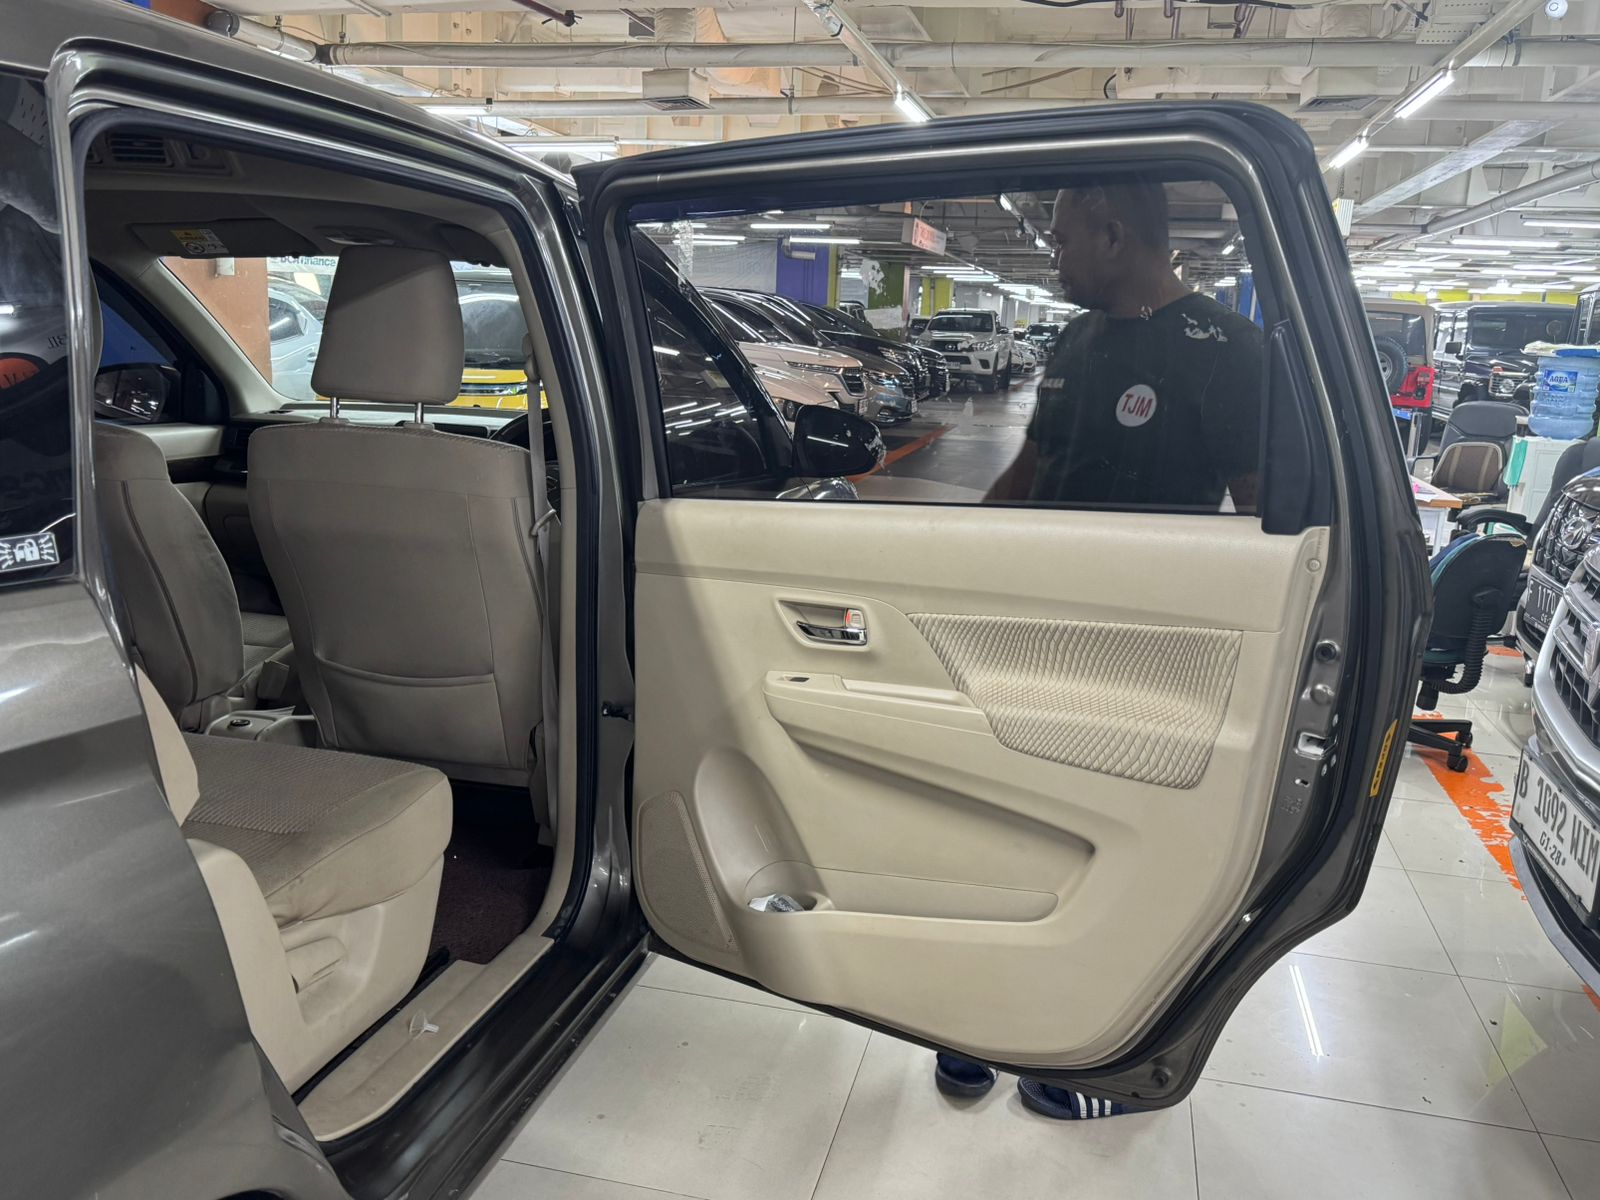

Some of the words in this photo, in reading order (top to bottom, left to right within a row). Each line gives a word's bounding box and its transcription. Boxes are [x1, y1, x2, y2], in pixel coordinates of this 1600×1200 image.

[1549, 375, 1568, 384] AQUA
[1121, 393, 1154, 419] TJM
[1527, 580, 1534, 602] F
[1537, 585, 1557, 615] 1170
[1518, 759, 1531, 799] B
[1534, 776, 1568, 845] 1092
[1569, 814, 1600, 884] WIM
